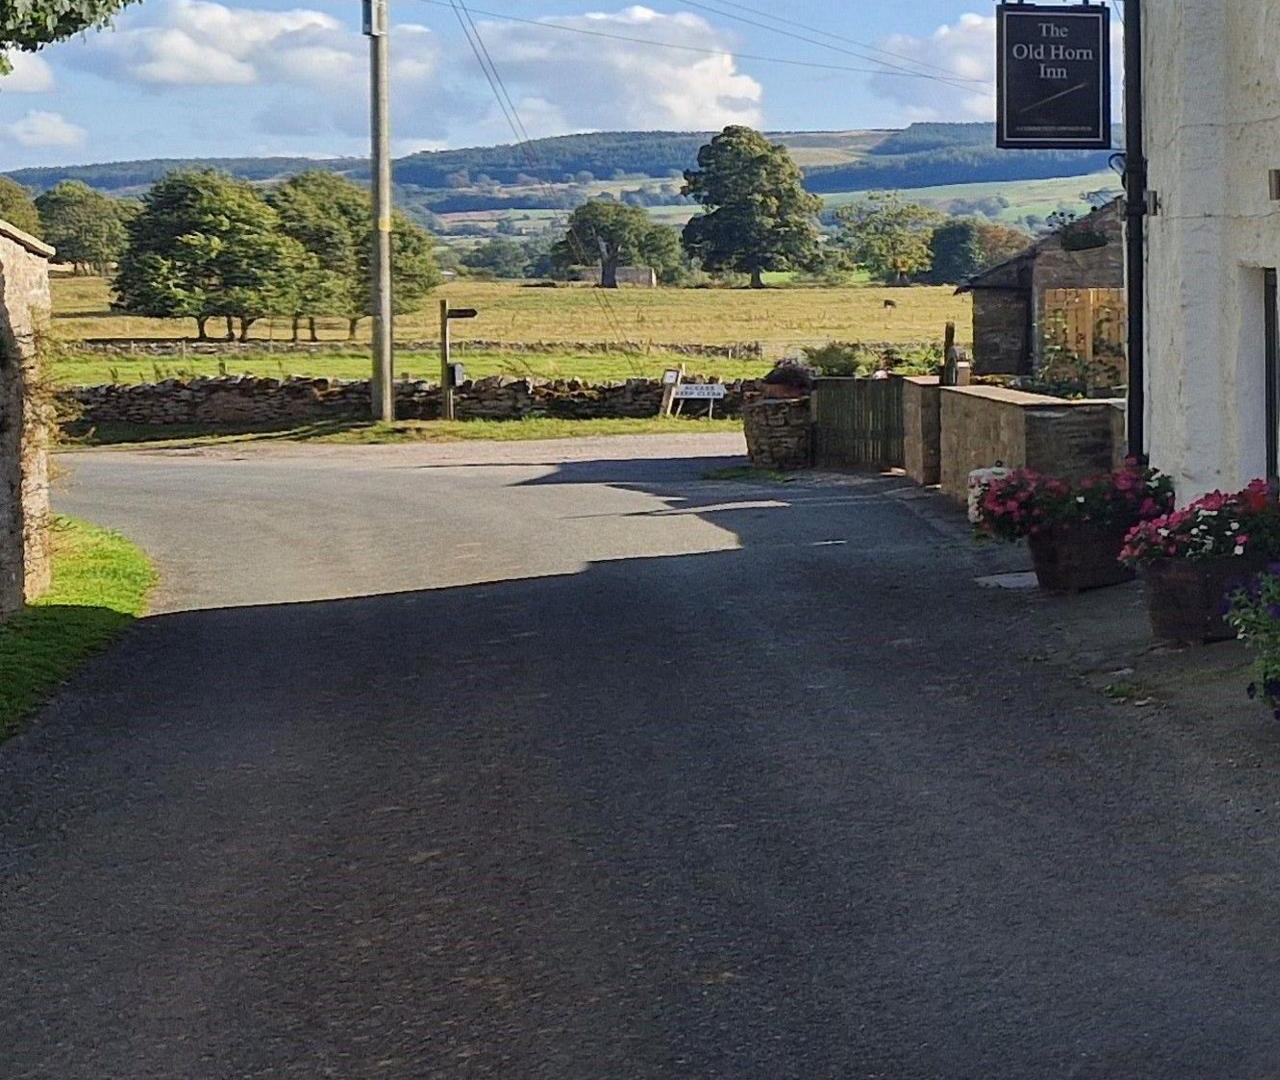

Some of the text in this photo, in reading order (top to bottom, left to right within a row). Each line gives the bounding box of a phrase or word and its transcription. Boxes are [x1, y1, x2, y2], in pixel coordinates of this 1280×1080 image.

[1038, 23, 1069, 38] The
[1012, 43, 1093, 61] Old Horn
[1039, 63, 1068, 79] Inn
